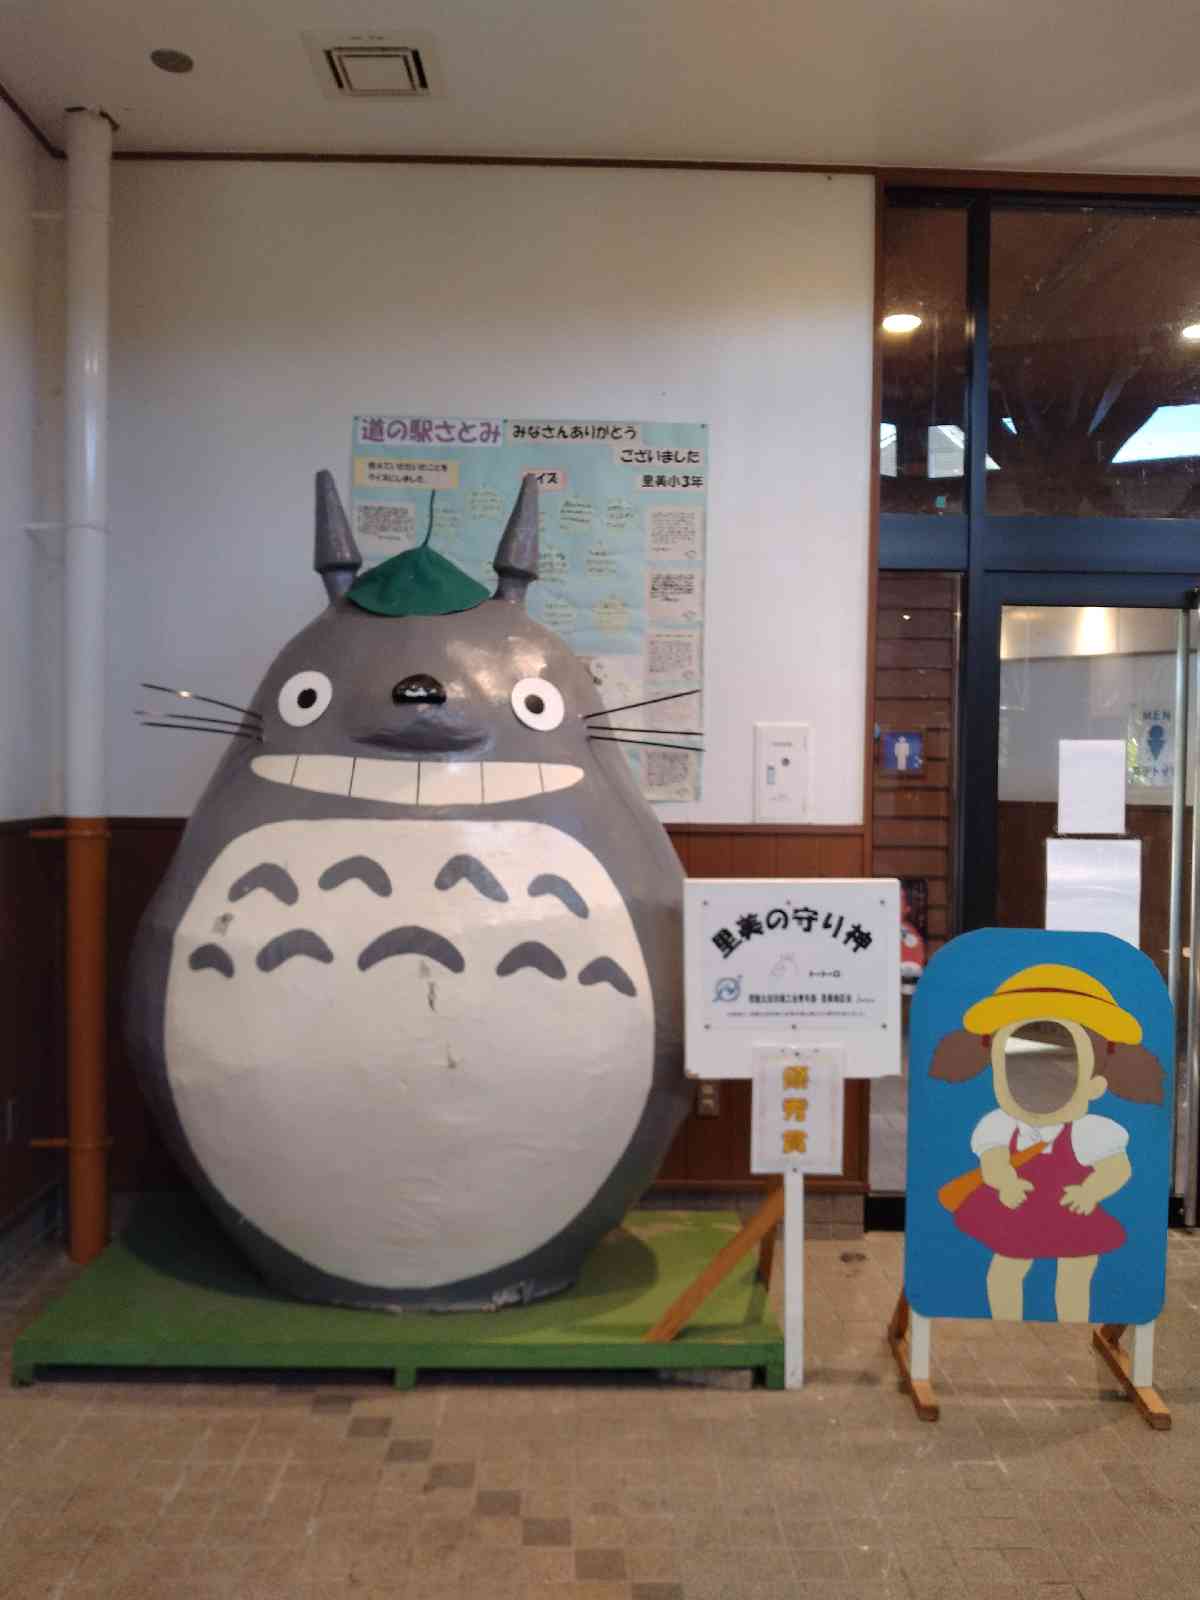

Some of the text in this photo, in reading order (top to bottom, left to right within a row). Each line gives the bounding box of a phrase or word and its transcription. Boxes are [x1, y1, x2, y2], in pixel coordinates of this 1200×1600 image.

[361, 418, 501, 442] 道の駅さとみ
[512, 425, 637, 439] みなさんありがとう
[712, 907, 873, 959] 里美の守り神
